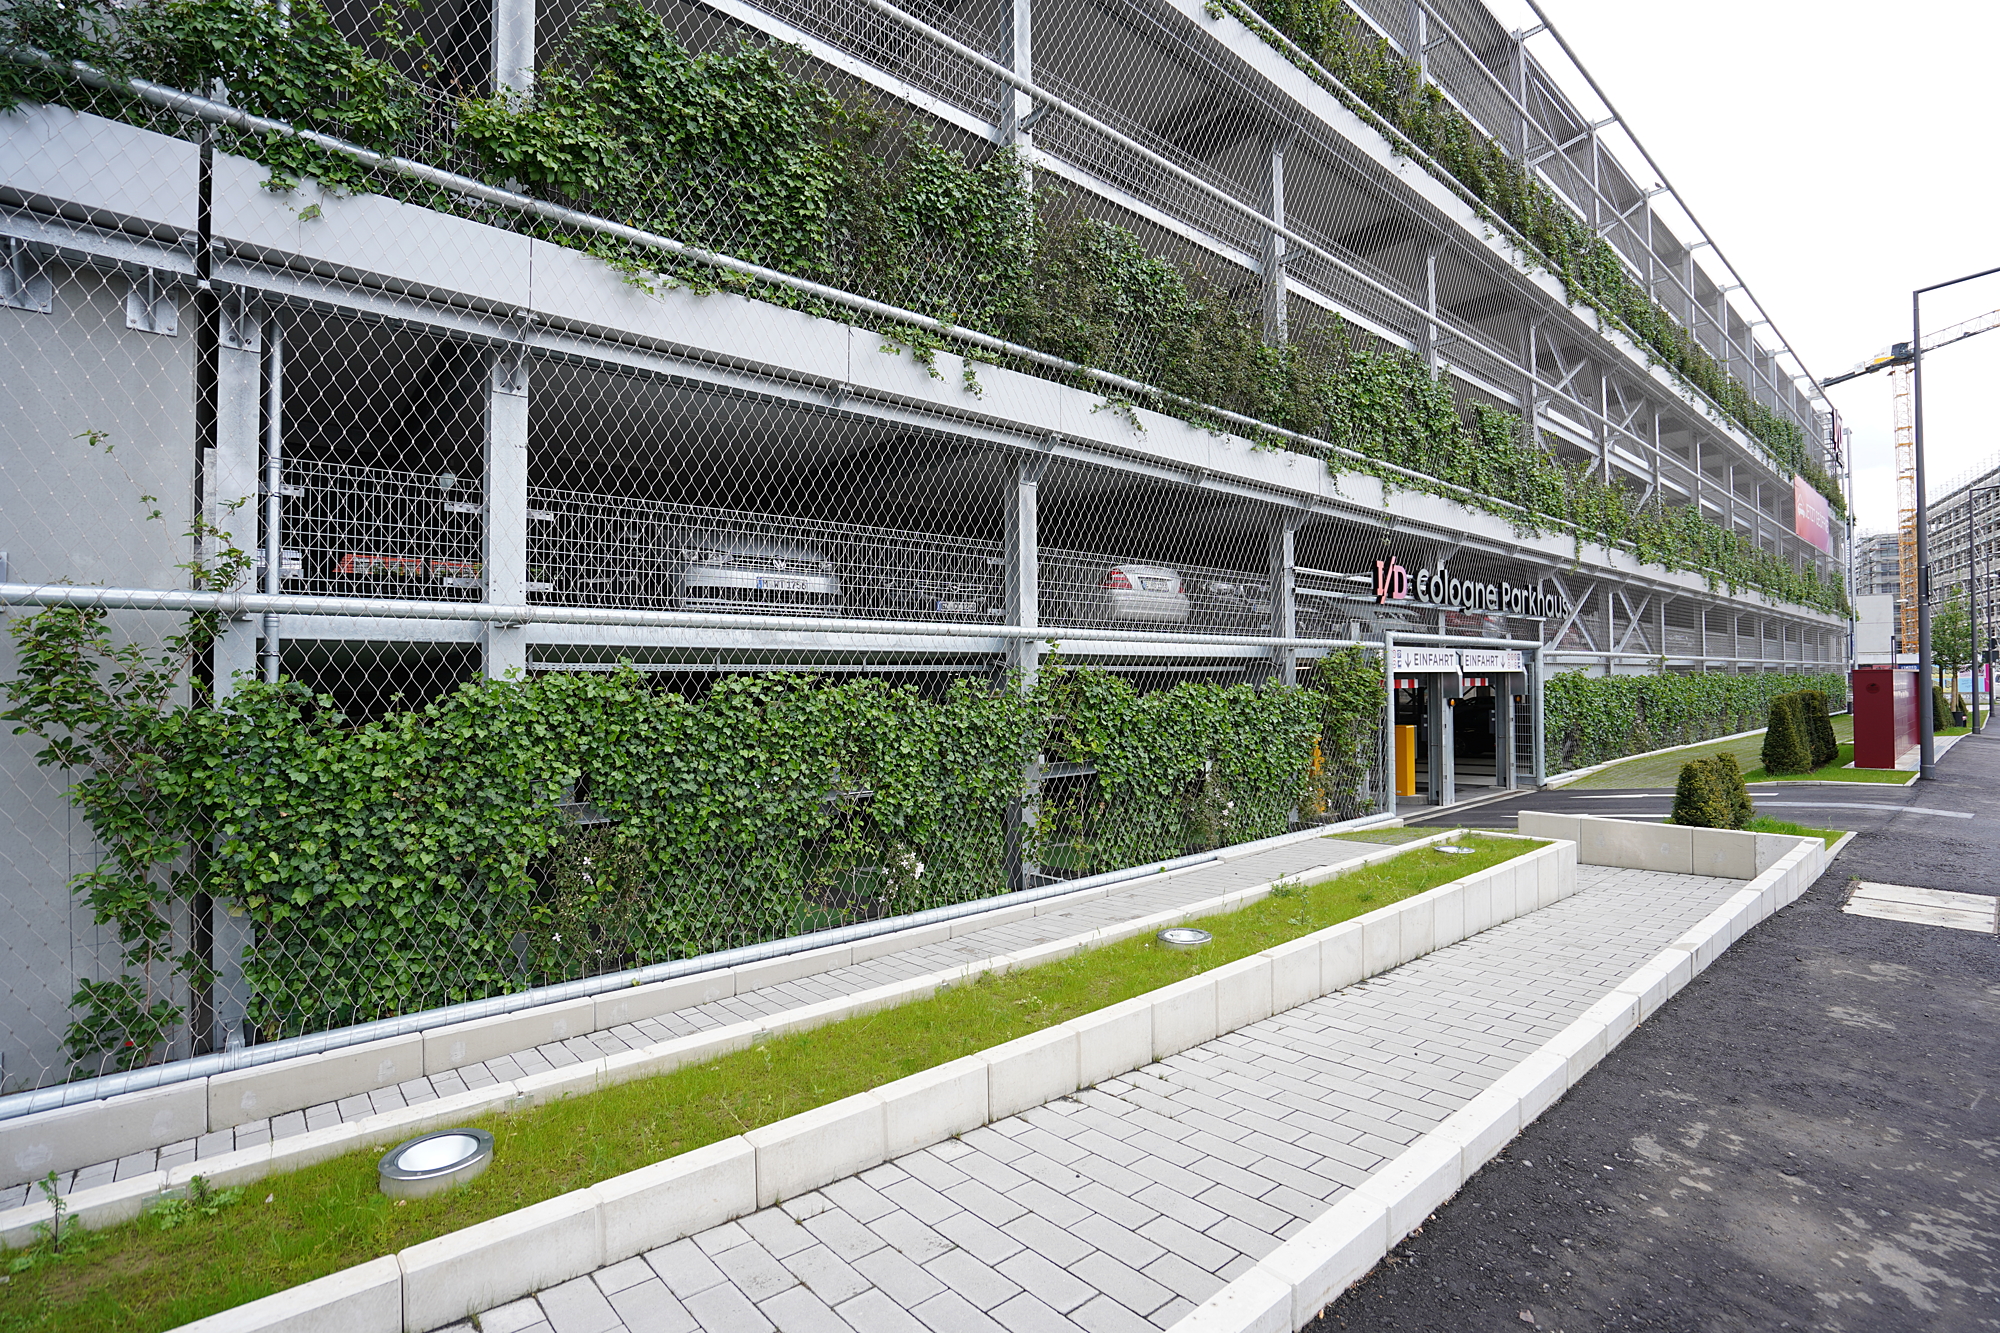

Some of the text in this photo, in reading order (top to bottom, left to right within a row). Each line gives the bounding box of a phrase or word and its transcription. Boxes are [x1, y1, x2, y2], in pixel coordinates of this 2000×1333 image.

[1416, 567, 1497, 616] Cologne
[1502, 581, 1571, 620] Parkhaus
[1413, 652, 1454, 667] EINFAHRT
[1465, 654, 1499, 668] EINFAHRT
